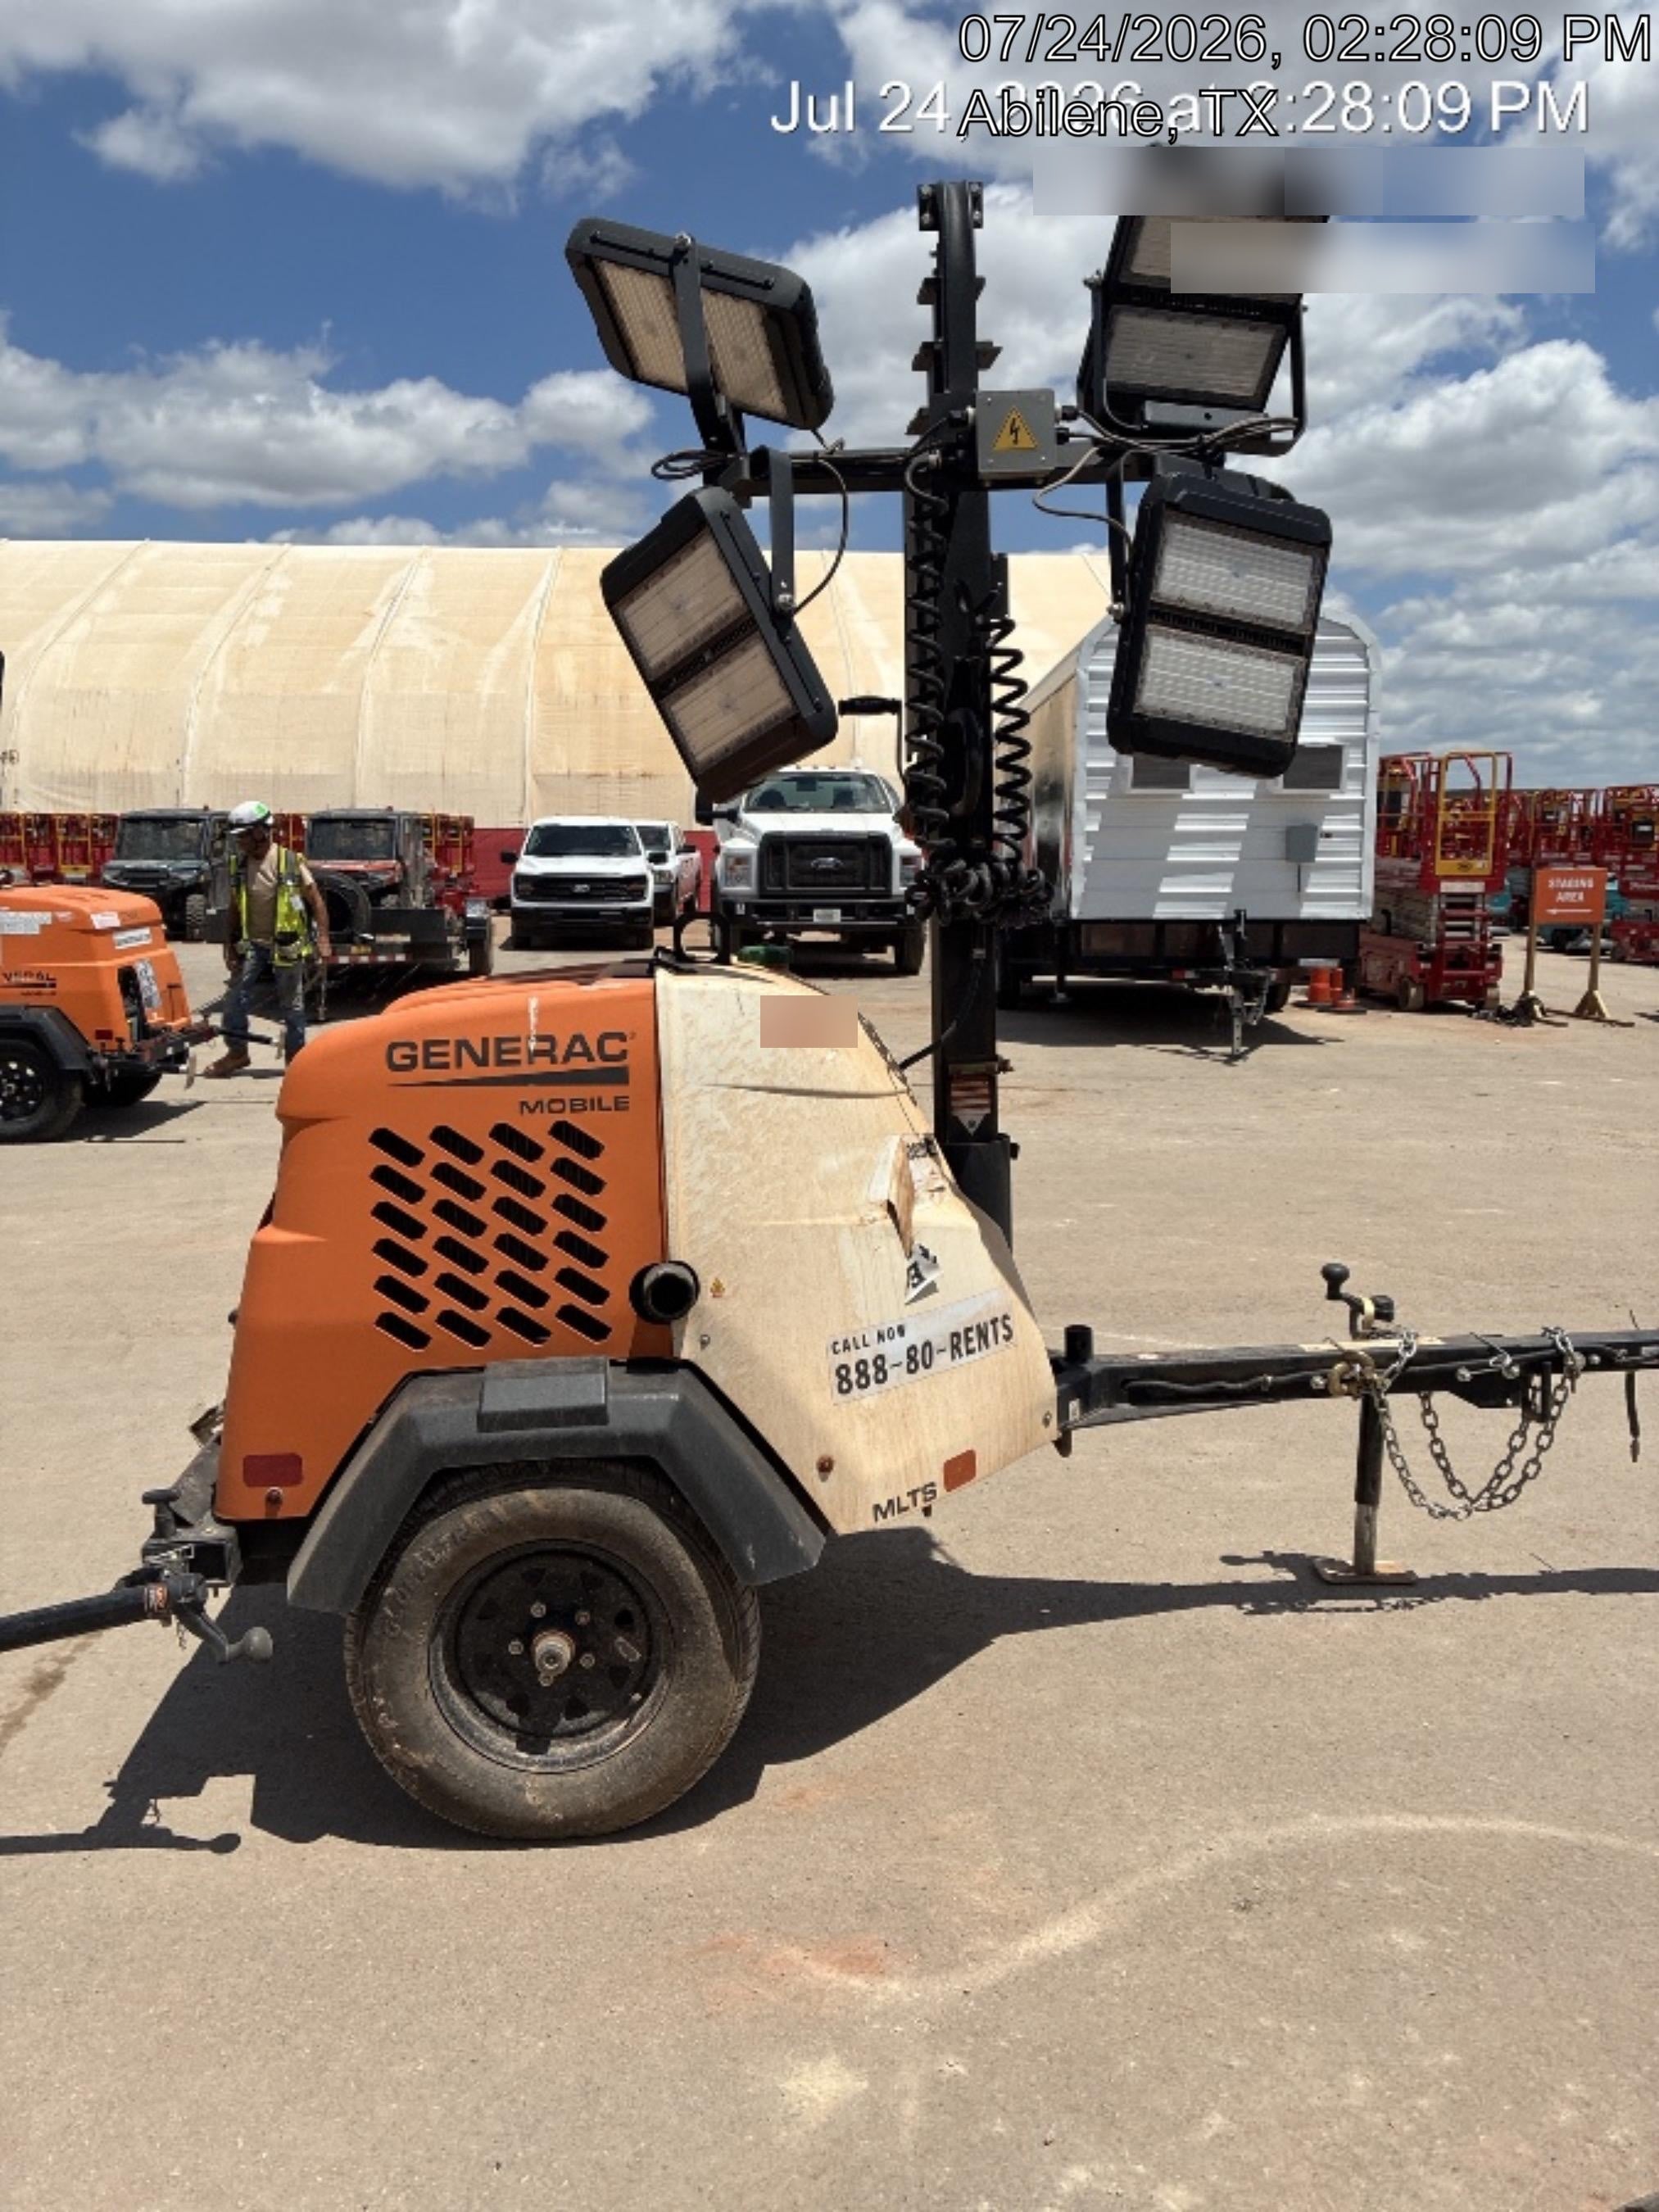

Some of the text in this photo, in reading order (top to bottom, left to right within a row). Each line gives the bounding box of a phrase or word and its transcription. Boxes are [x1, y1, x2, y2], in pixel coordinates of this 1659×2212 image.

[1548, 877, 1594, 889] STAGING
[386, 1031, 628, 1072] GENERAC
[519, 1095, 630, 1116] MOBILE
[832, 1324, 906, 1355] CALL NOW
[835, 1313, 1014, 1394] 888-80-RENTS
